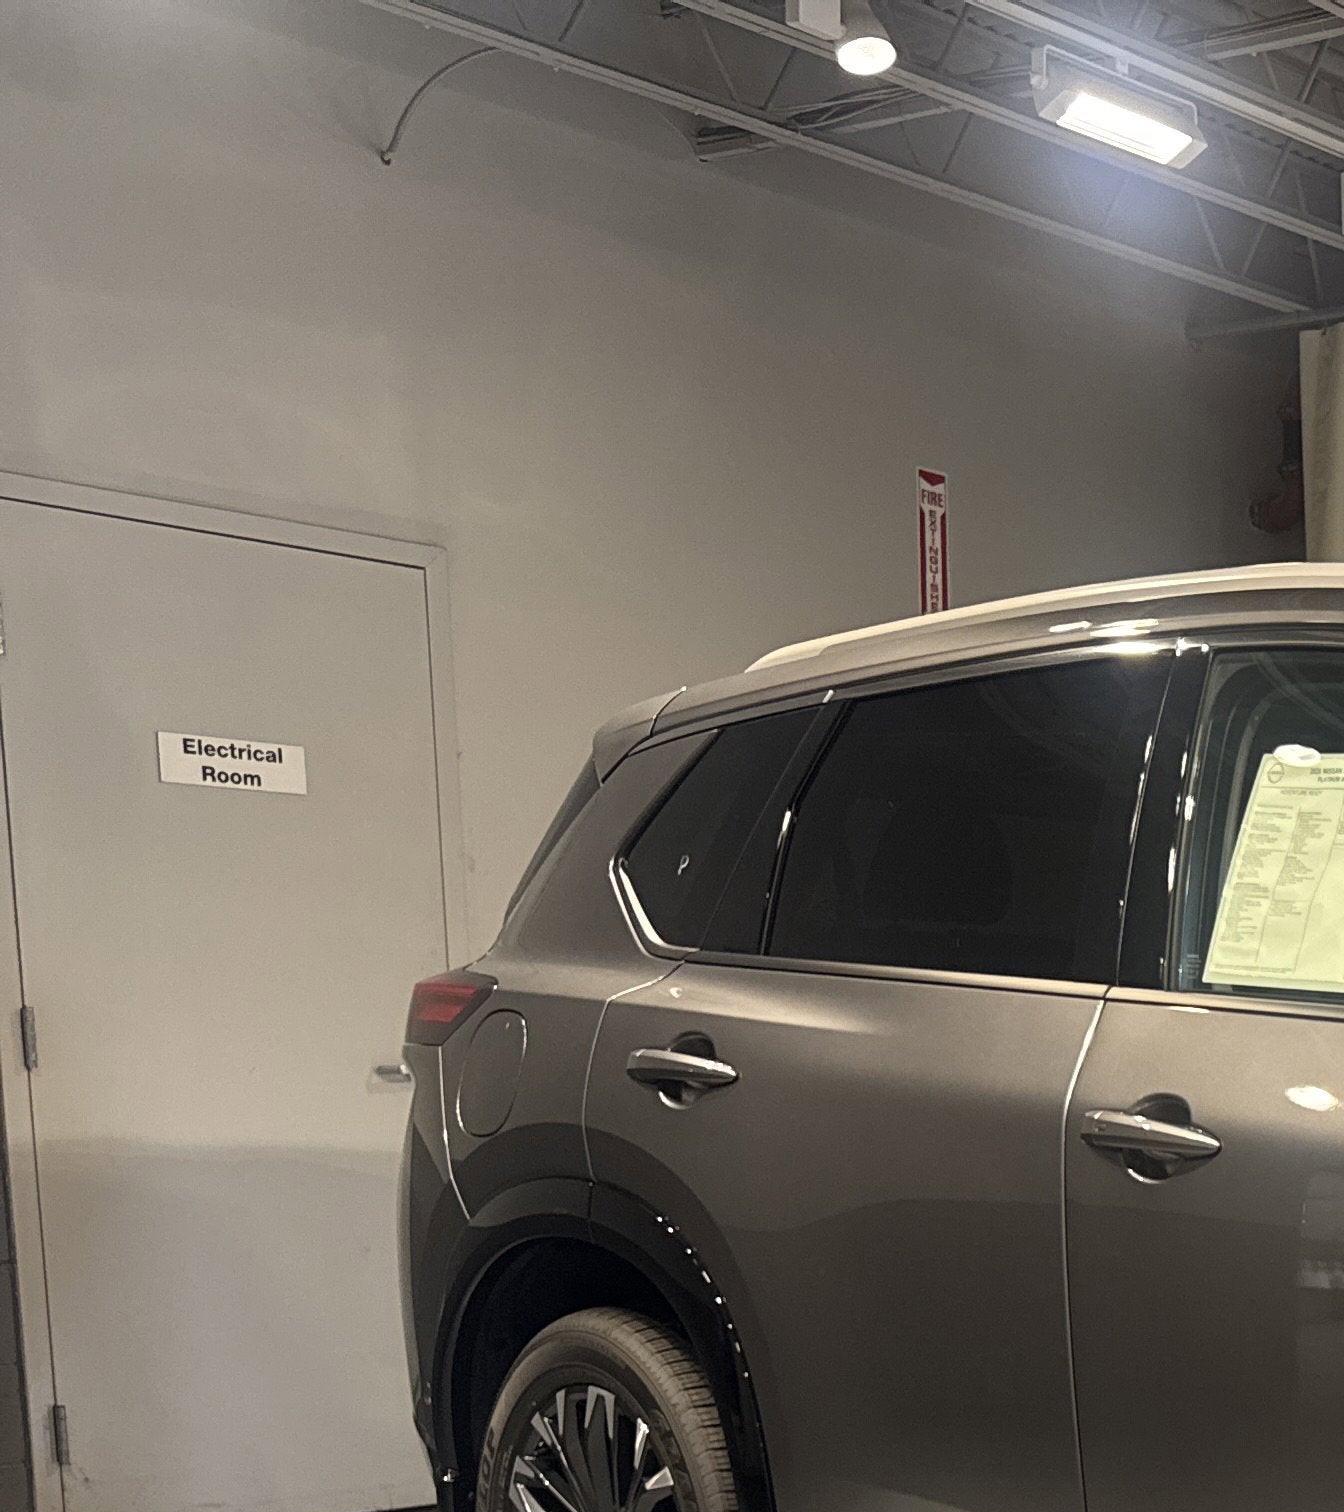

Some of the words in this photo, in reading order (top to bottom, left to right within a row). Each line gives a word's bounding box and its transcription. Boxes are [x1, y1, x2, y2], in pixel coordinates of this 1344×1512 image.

[921, 488, 944, 508] FIRE
[182, 737, 284, 764] Electrical
[201, 765, 263, 787] Room
